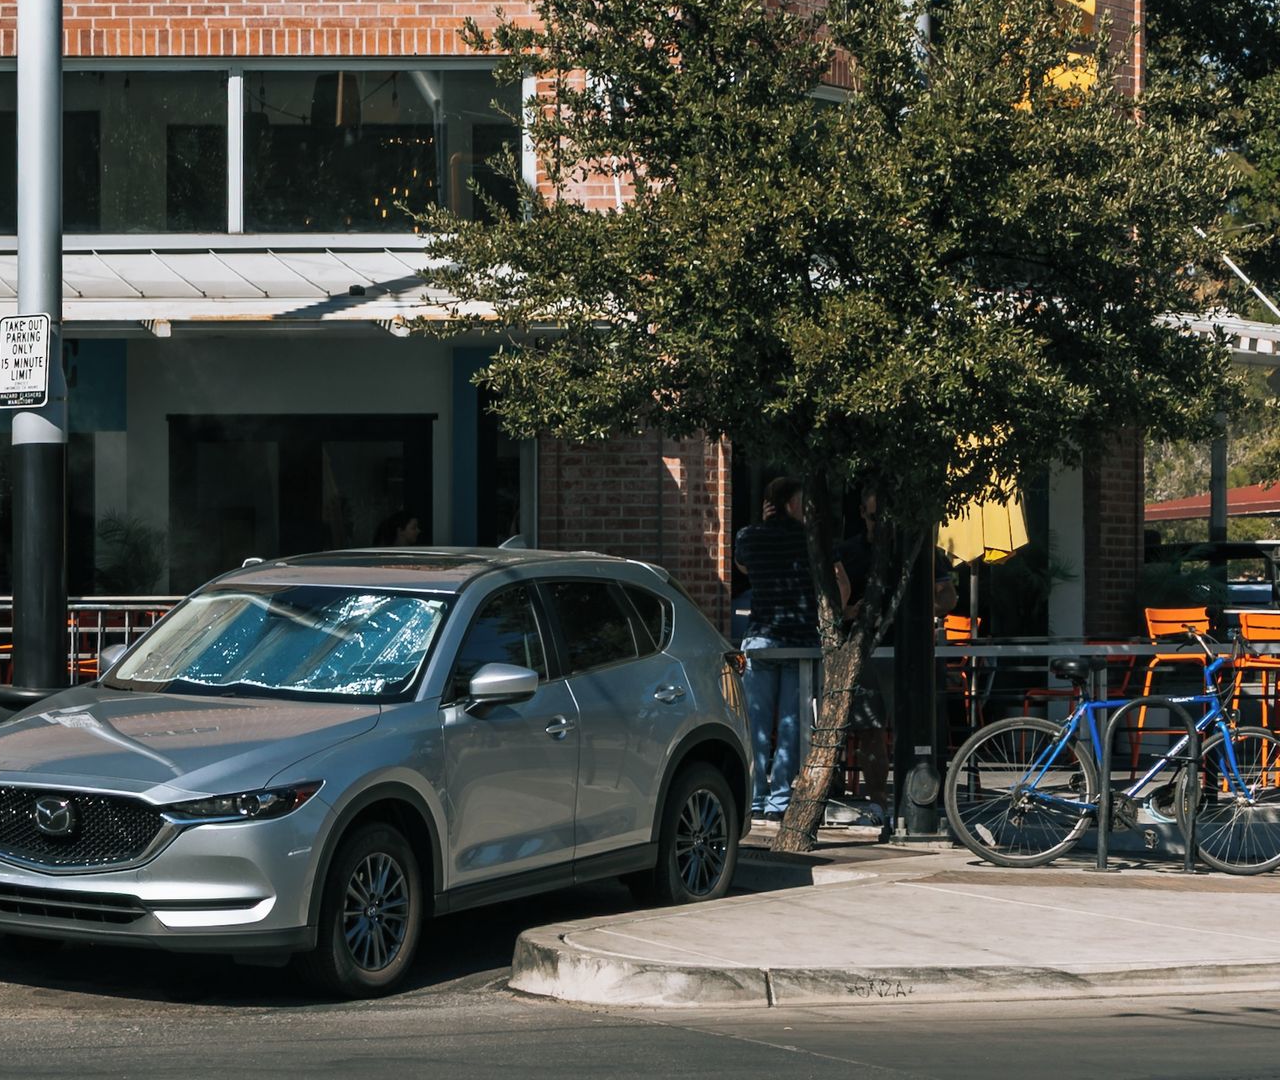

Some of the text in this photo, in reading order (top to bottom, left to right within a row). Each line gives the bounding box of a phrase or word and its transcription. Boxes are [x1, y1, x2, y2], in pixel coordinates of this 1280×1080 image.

[28, 319, 43, 331] OUT
[6, 331, 41, 343] PARKING
[12, 343, 34, 355] ONLY
[1, 357, 43, 370] 15 MINUTE
[11, 368, 33, 381] LIMIT
